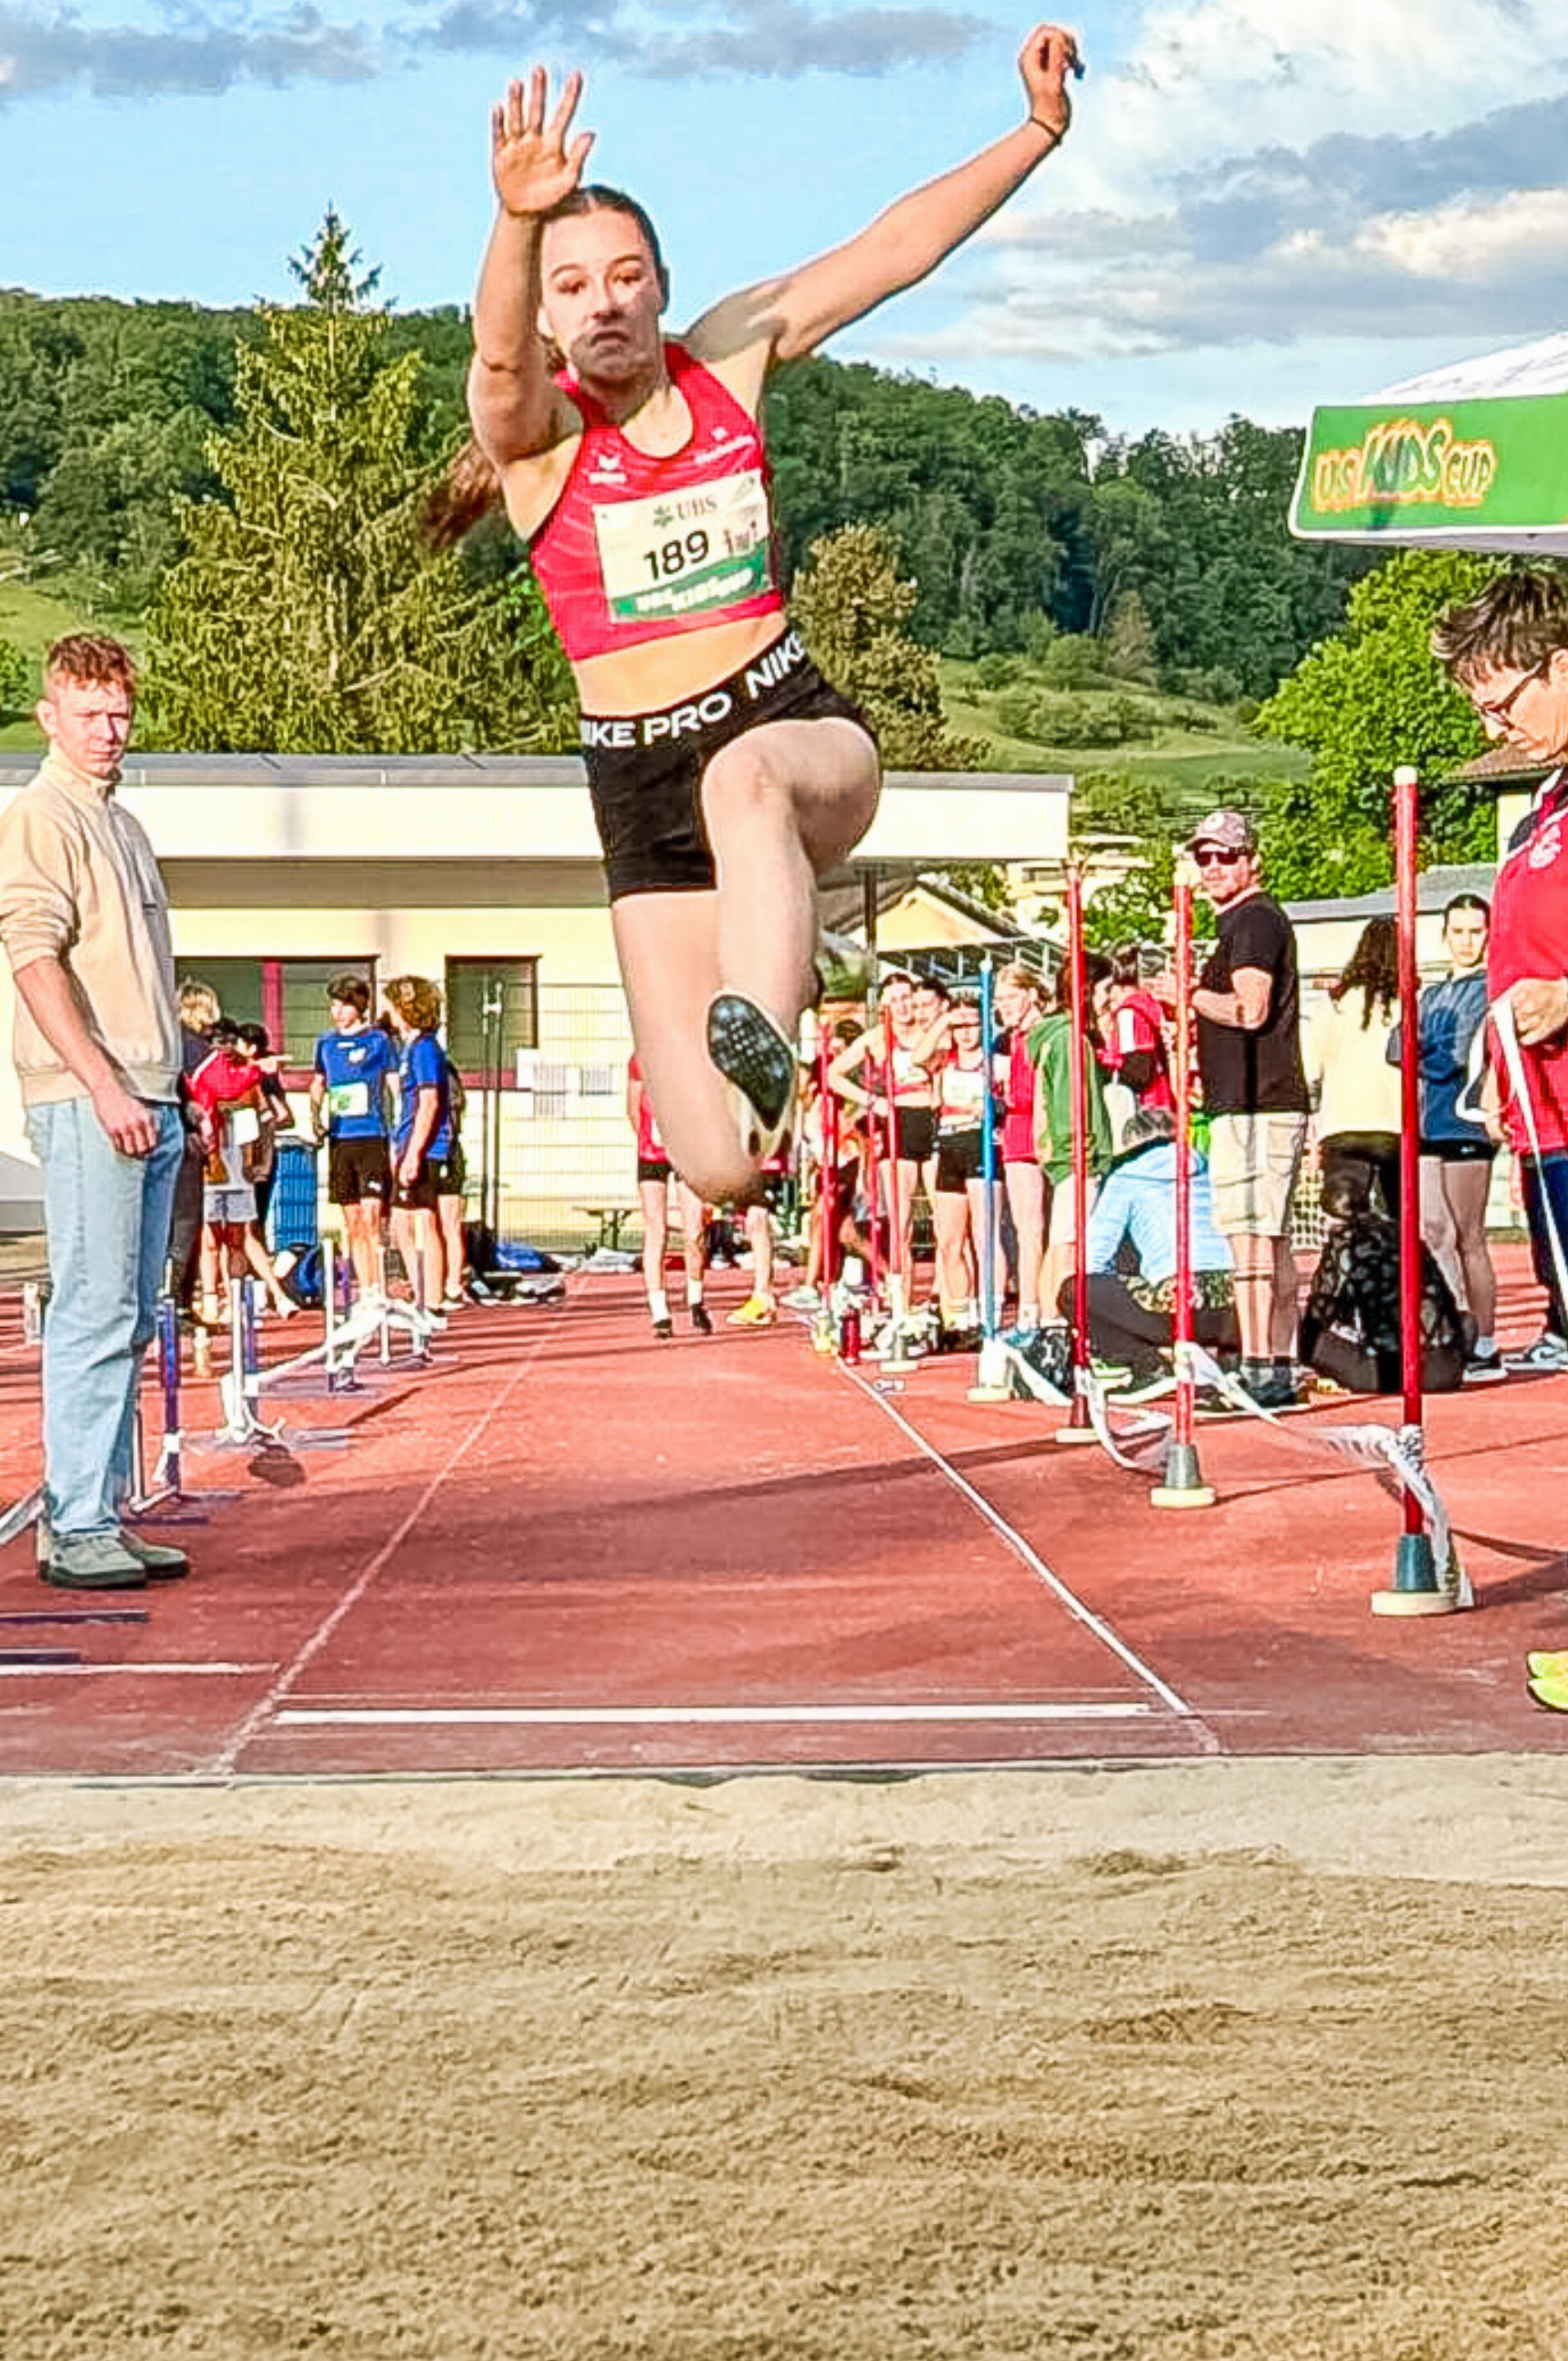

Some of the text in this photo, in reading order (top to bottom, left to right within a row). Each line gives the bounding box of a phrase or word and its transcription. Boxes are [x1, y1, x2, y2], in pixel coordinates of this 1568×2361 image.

[1443, 441, 1496, 506] CUP
[643, 529, 709, 581] 189
[581, 719, 636, 747] IKE
[644, 692, 732, 745] PRO
